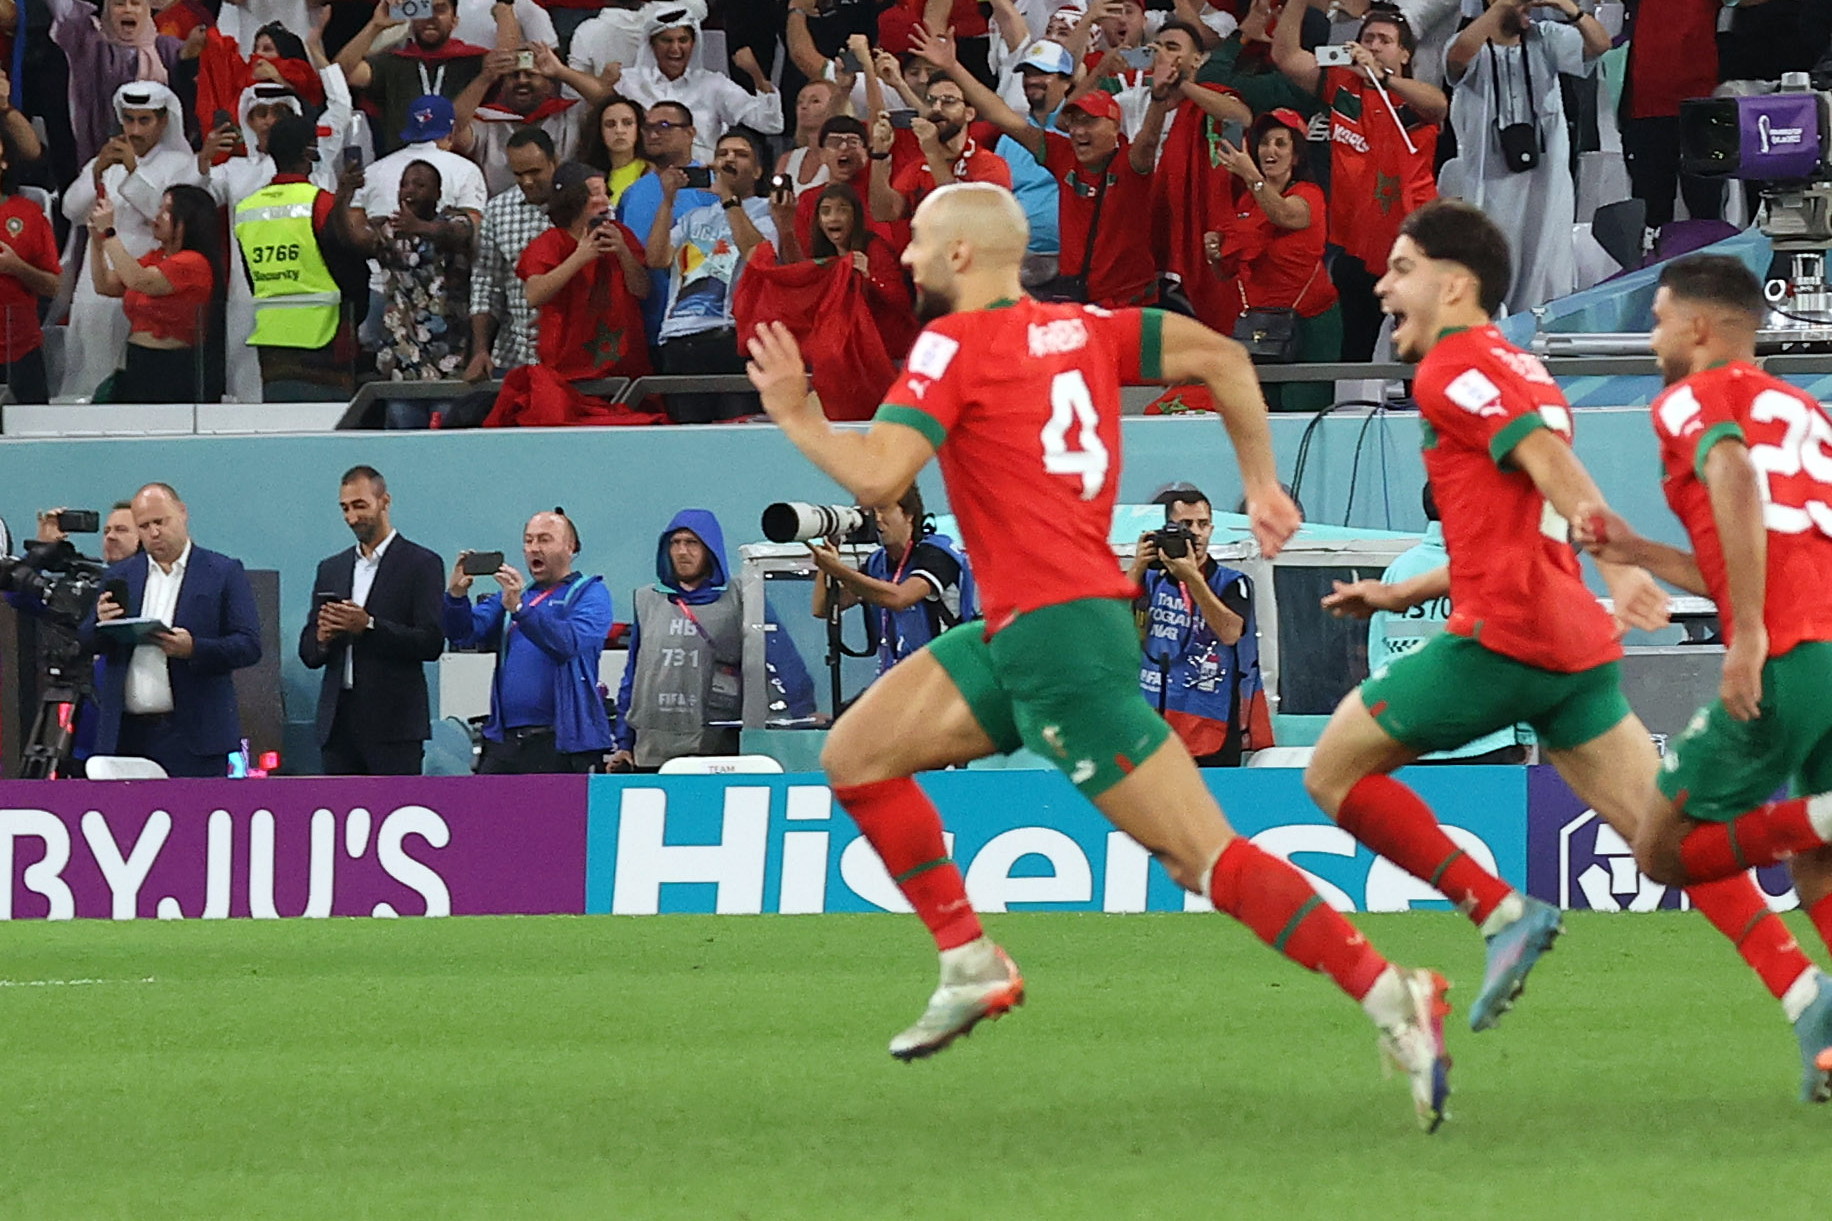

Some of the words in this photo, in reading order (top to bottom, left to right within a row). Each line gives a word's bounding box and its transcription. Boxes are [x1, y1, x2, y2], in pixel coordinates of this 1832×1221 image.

[252, 244, 300, 264] 3766
[1041, 368, 1110, 500] 4
[661, 648, 699, 668] 731
[708, 765, 736, 774] TEAM
[0, 806, 451, 919] BYJU'S
